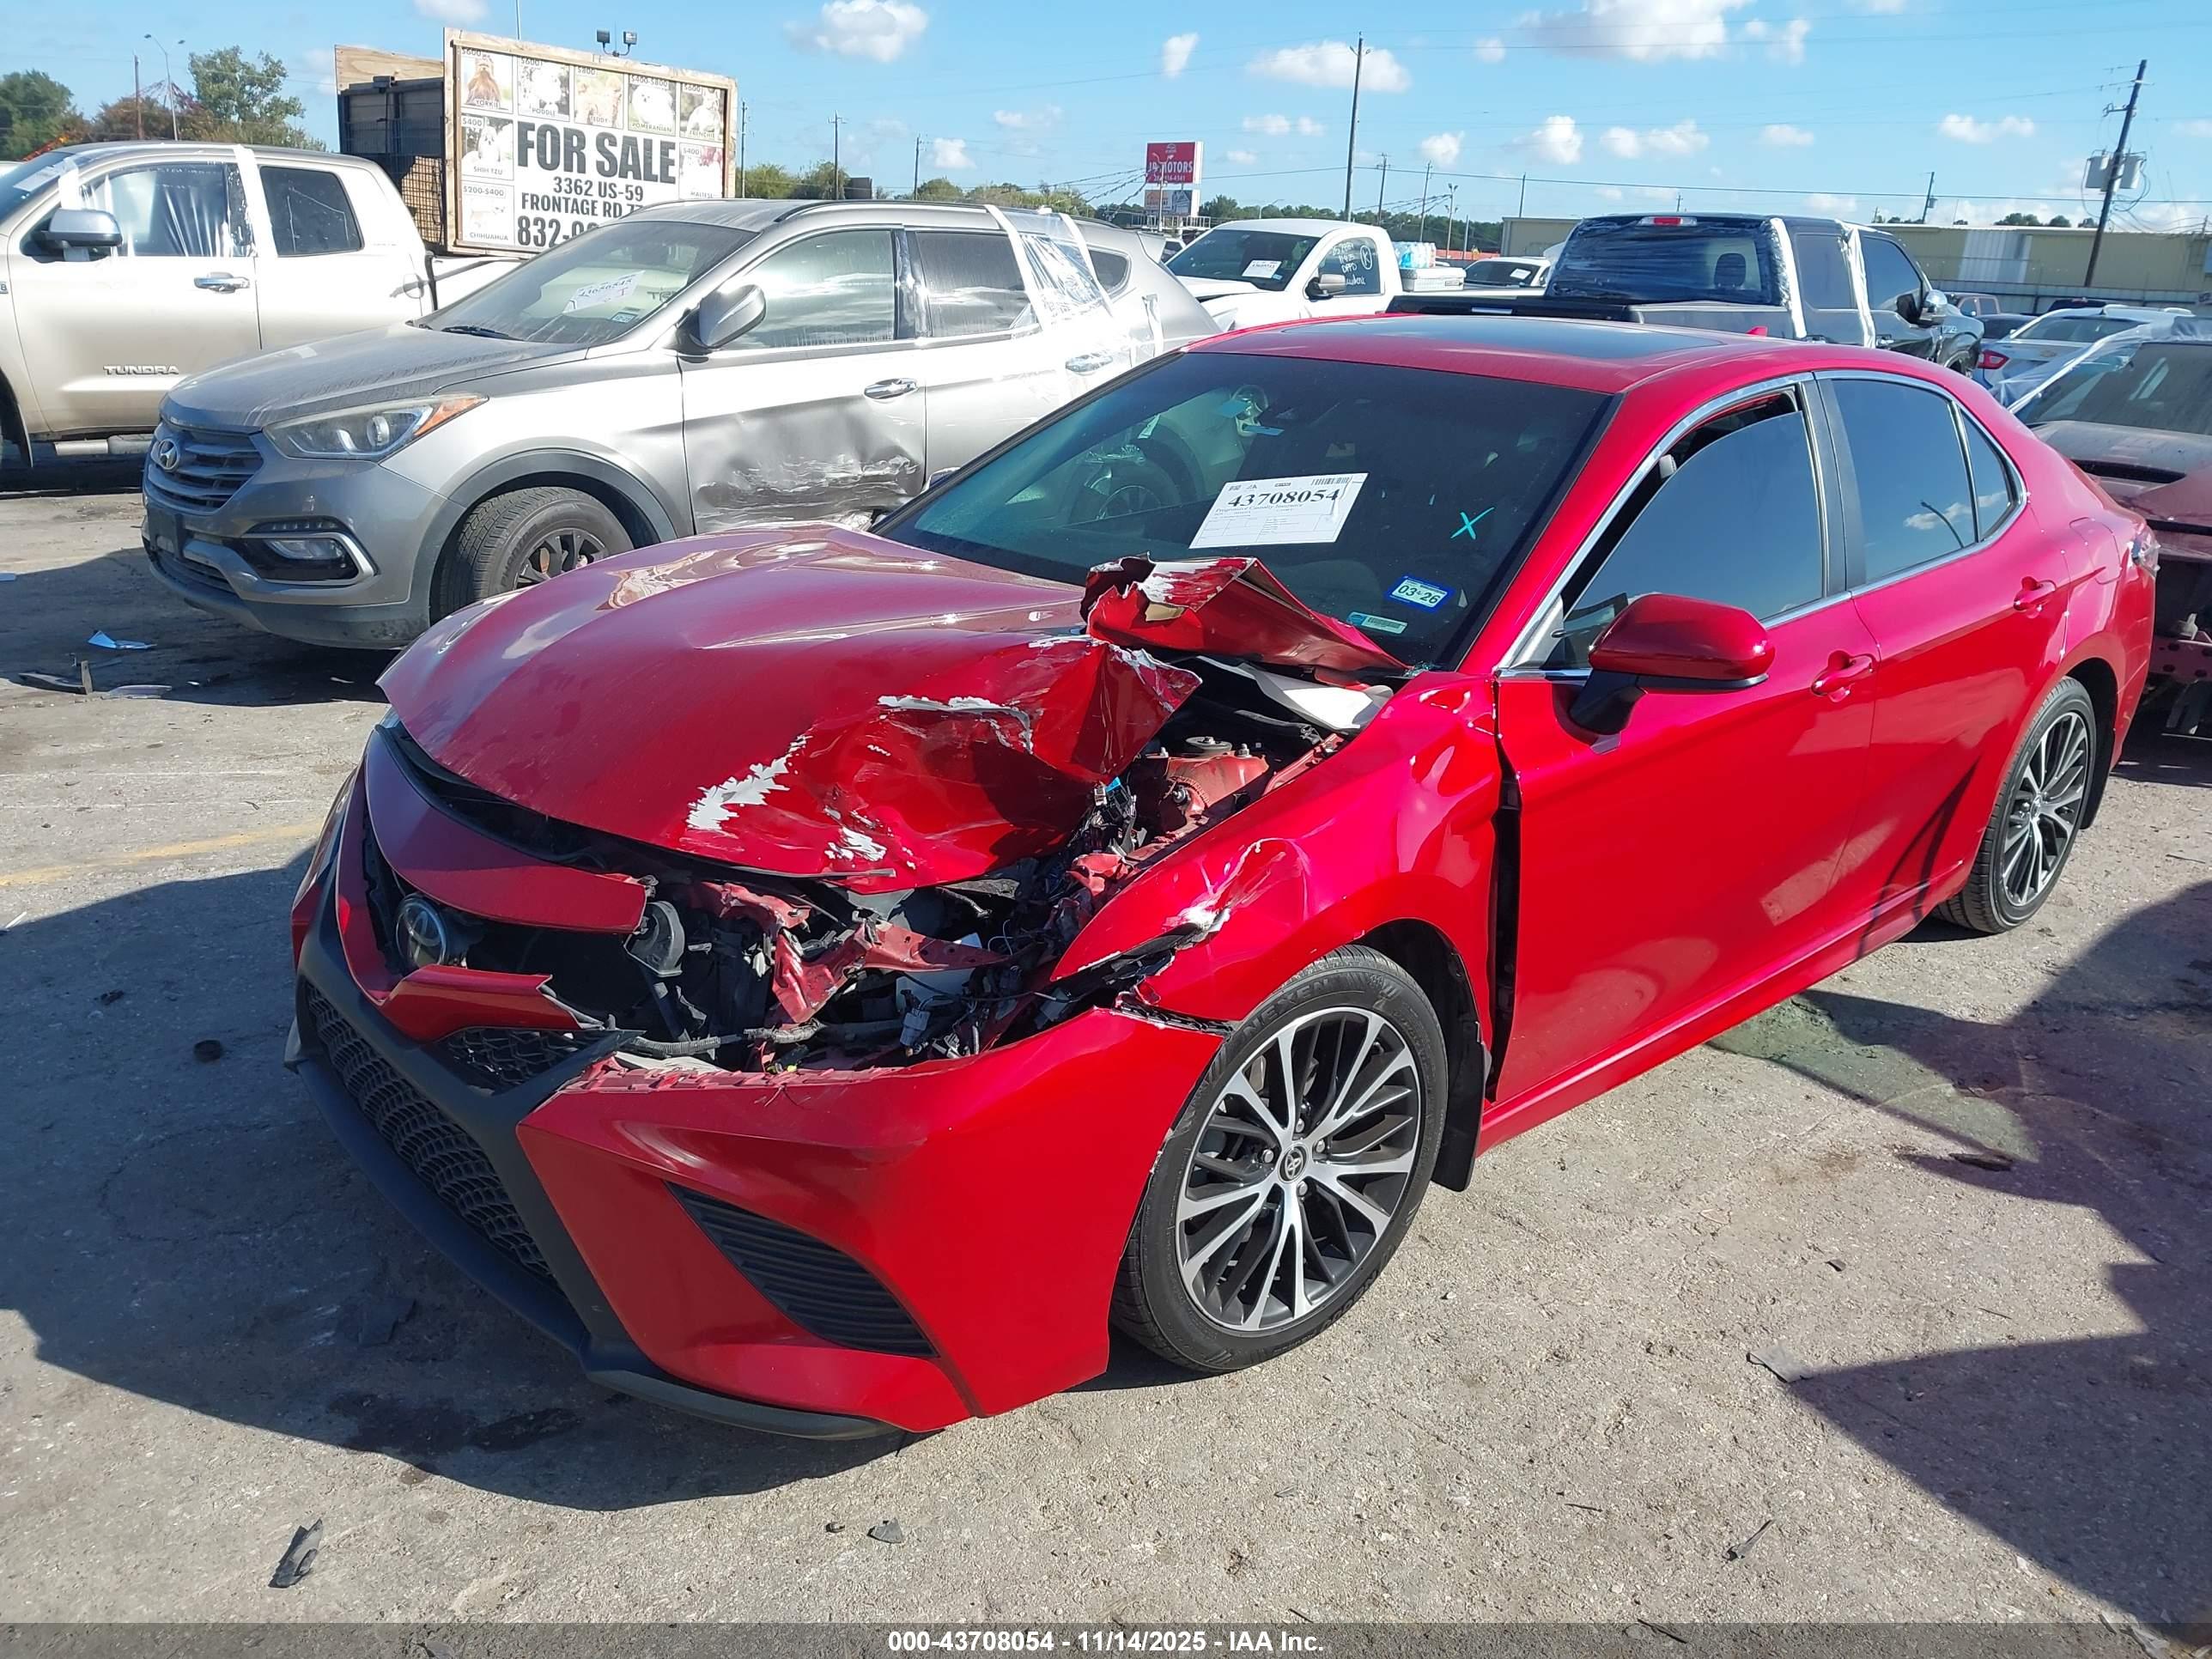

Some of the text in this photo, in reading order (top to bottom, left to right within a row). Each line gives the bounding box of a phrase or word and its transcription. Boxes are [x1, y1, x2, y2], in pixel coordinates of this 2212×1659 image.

[463, 118, 483, 126] $400
[631, 123, 672, 132] POMERANIAN
[517, 120, 677, 185] FOR SALE
[463, 185, 505, 197] $200-$400
[553, 176, 644, 202] 3362 US-59
[521, 191, 599, 216] FRONTAGE
[603, 201, 623, 218] RD
[469, 232, 508, 240] CHIHUAHUA
[103, 365, 179, 375] TUNDRA
[1228, 488, 1340, 507] 43708054
[1398, 585, 1441, 604] 03 26
[1243, 978, 1330, 1036] NEXEN
